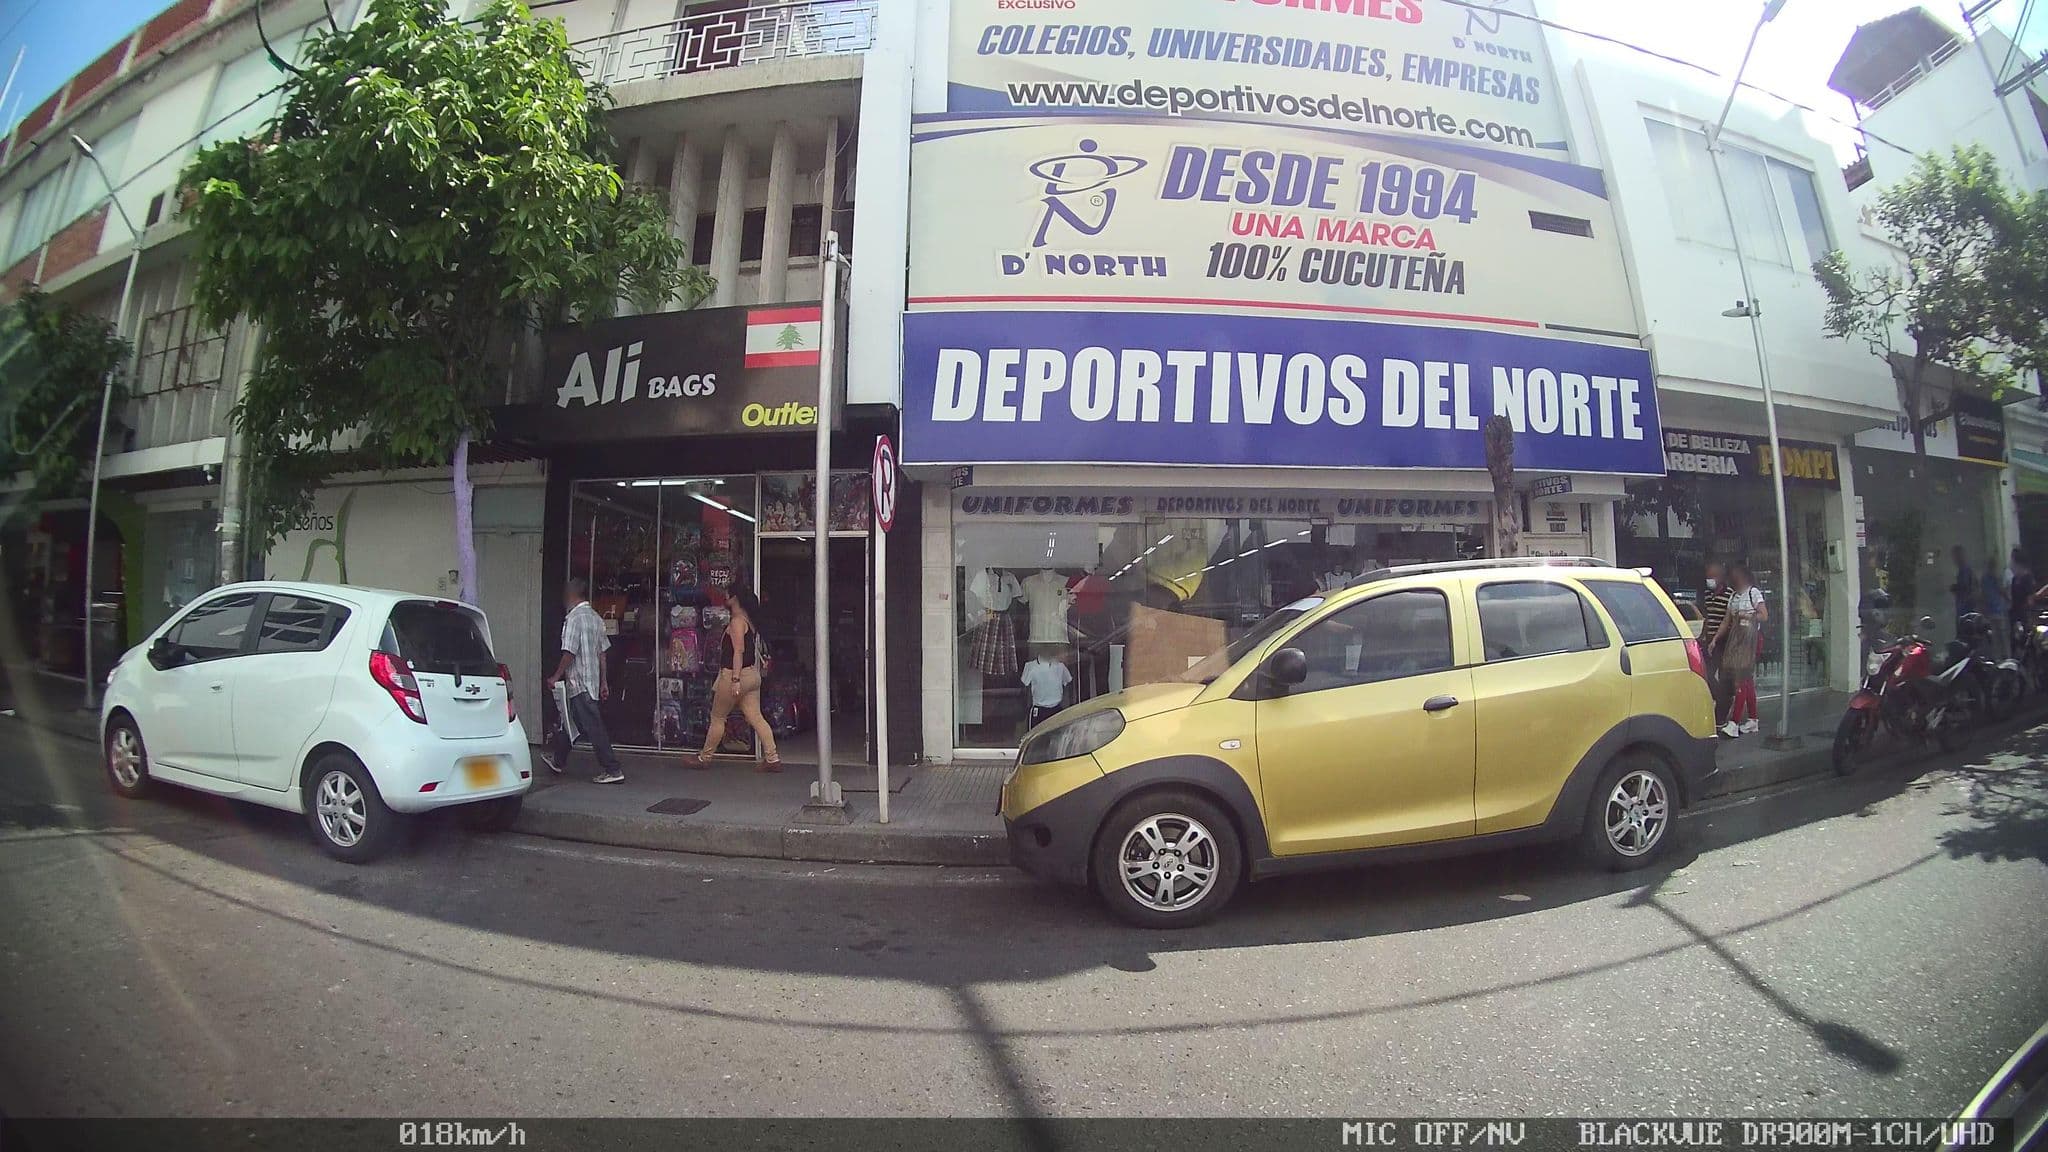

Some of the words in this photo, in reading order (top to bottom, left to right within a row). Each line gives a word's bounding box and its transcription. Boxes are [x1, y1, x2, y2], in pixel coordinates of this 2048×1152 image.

[998, 0, 1076, 9] EXCLUSIVO
[977, 24, 1136, 60] COLEGIOS,
[1147, 27, 1393, 82] UNIVERSIDADES,
[1401, 53, 1540, 105] EMPRESAS
[1473, 40, 1533, 63] NORTH
[1008, 79, 1535, 148] www.deportivosdelnorte.com
[1161, 145, 1345, 210] DESDE
[1359, 161, 1480, 225] 1994
[1232, 212, 1305, 240] UNA
[1316, 218, 1437, 250] MARCA
[1045, 253, 1167, 277] NORTH
[1206, 242, 1292, 282] 100%
[1298, 247, 1466, 295] CUCUTEÑA
[556, 340, 643, 408] Ali
[648, 373, 716, 399] BAGS
[931, 346, 1368, 427] DEPORTIVOS
[1382, 358, 1479, 431] DEL
[1492, 366, 1644, 441] NORTE
[1690, 434, 1750, 455] BELLEZA
[961, 495, 1133, 515] UNIFORMES
[1336, 498, 1479, 517] UNIFORMES
